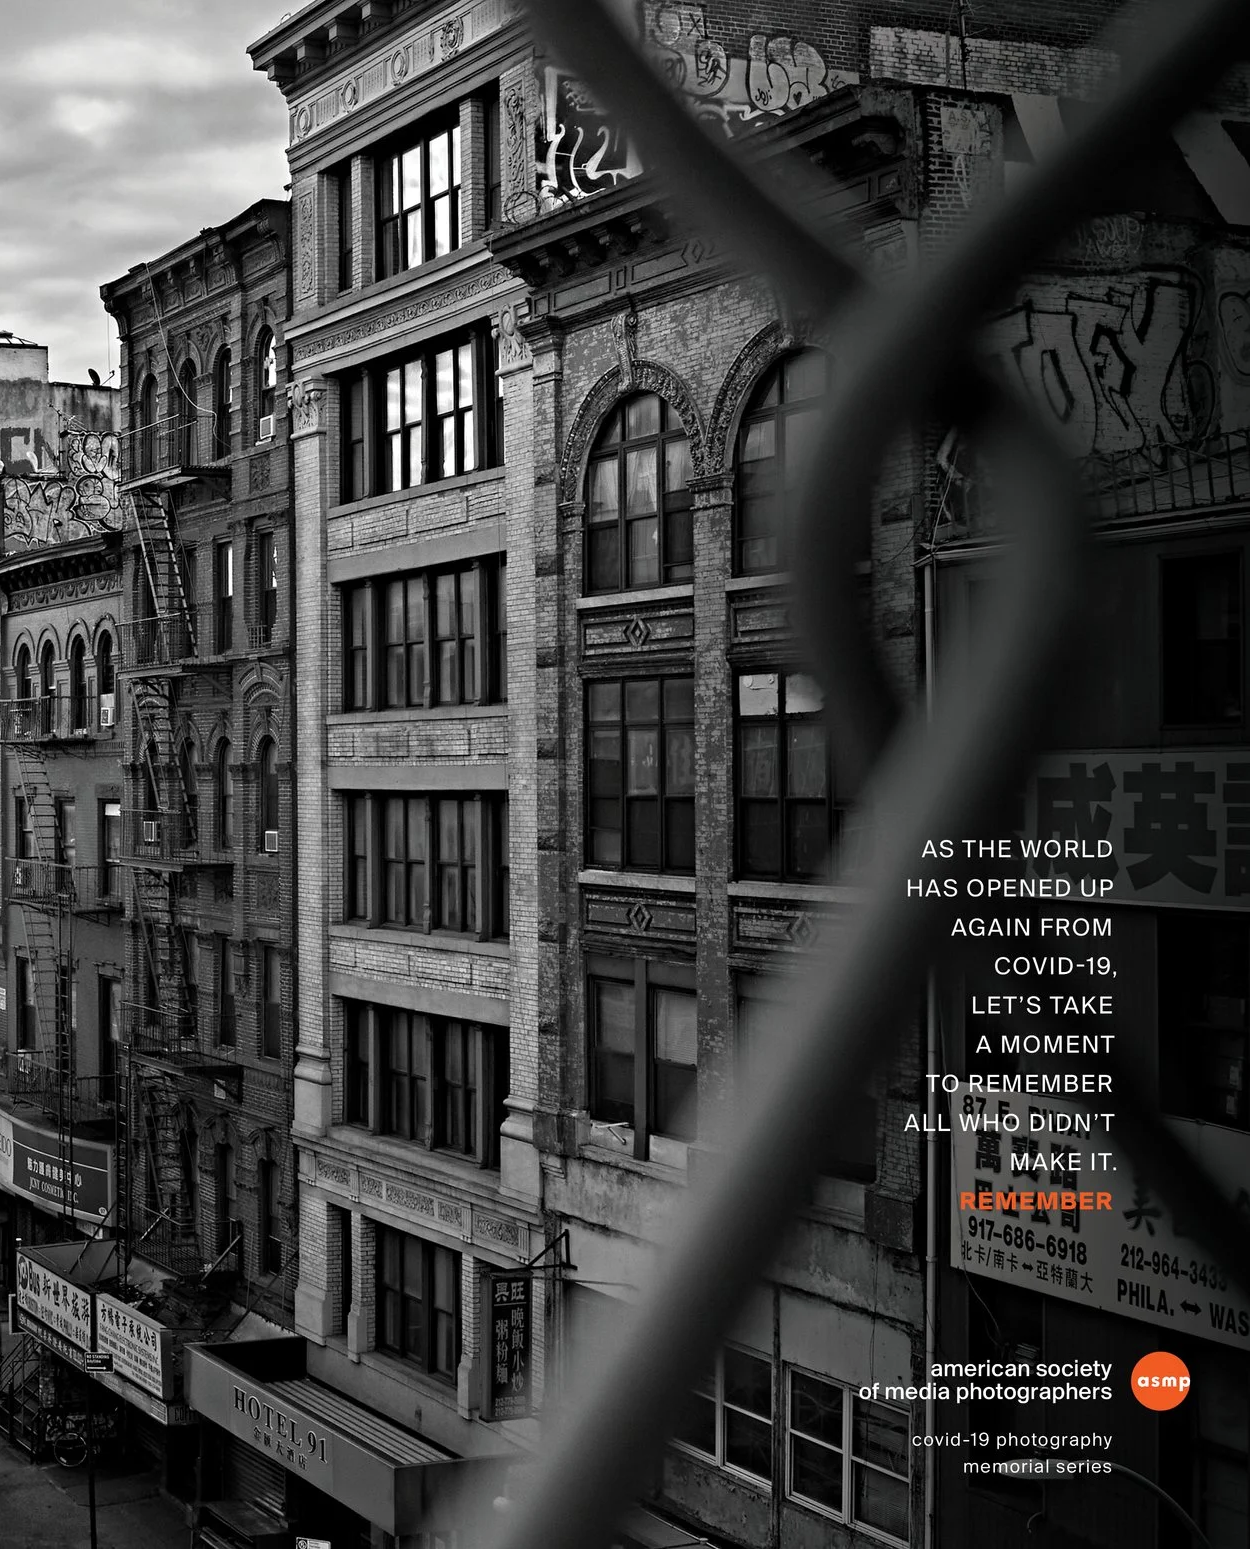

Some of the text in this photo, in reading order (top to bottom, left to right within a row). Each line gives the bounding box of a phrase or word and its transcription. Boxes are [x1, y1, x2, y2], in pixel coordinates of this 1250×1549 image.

[963, 1095, 986, 1118] 87
[968, 1216, 1087, 1266] 917-686-6918
[1117, 1279, 1175, 1316] PHILA.
[233, 1385, 329, 1464] HOTEL 91
